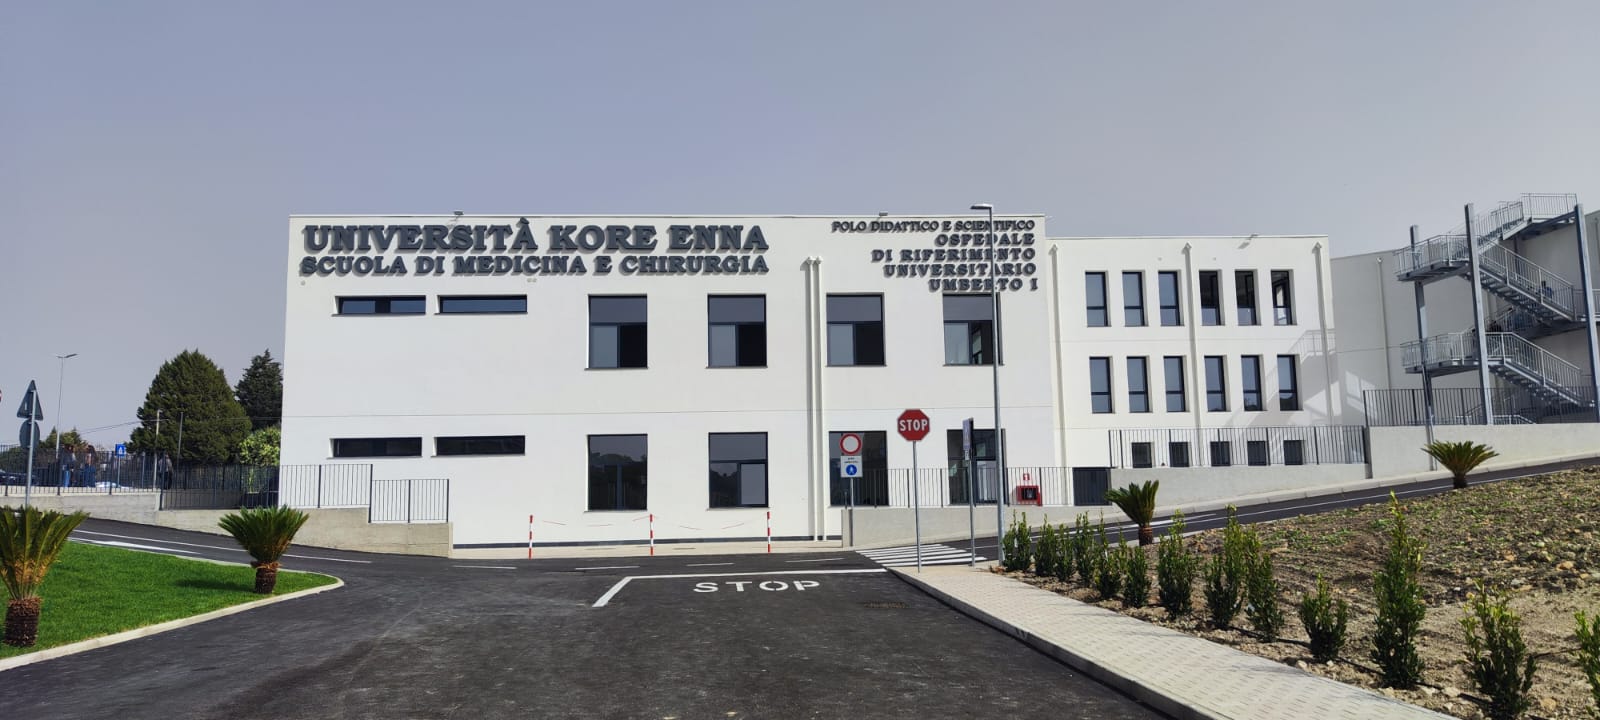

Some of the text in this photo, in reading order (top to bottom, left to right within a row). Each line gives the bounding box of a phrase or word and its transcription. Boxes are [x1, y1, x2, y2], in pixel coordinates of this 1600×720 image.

[832, 220, 1035, 232] POLO DIDATTICO E SCIENTIFICO
[303, 217, 769, 250] UNIVERSITÀ KORE ENNA
[936, 233, 1035, 246] OSPEDALE
[872, 248, 1036, 261] DI RIFERIMENTO
[301, 256, 769, 274] SCUOLA DI MEDICINA E CHIRURGIA
[884, 263, 1036, 276] UNIVERSITARIO
[1030, 278, 1038, 290] I
[899, 419, 928, 431] STOP
[693, 580, 820, 592] STOP
